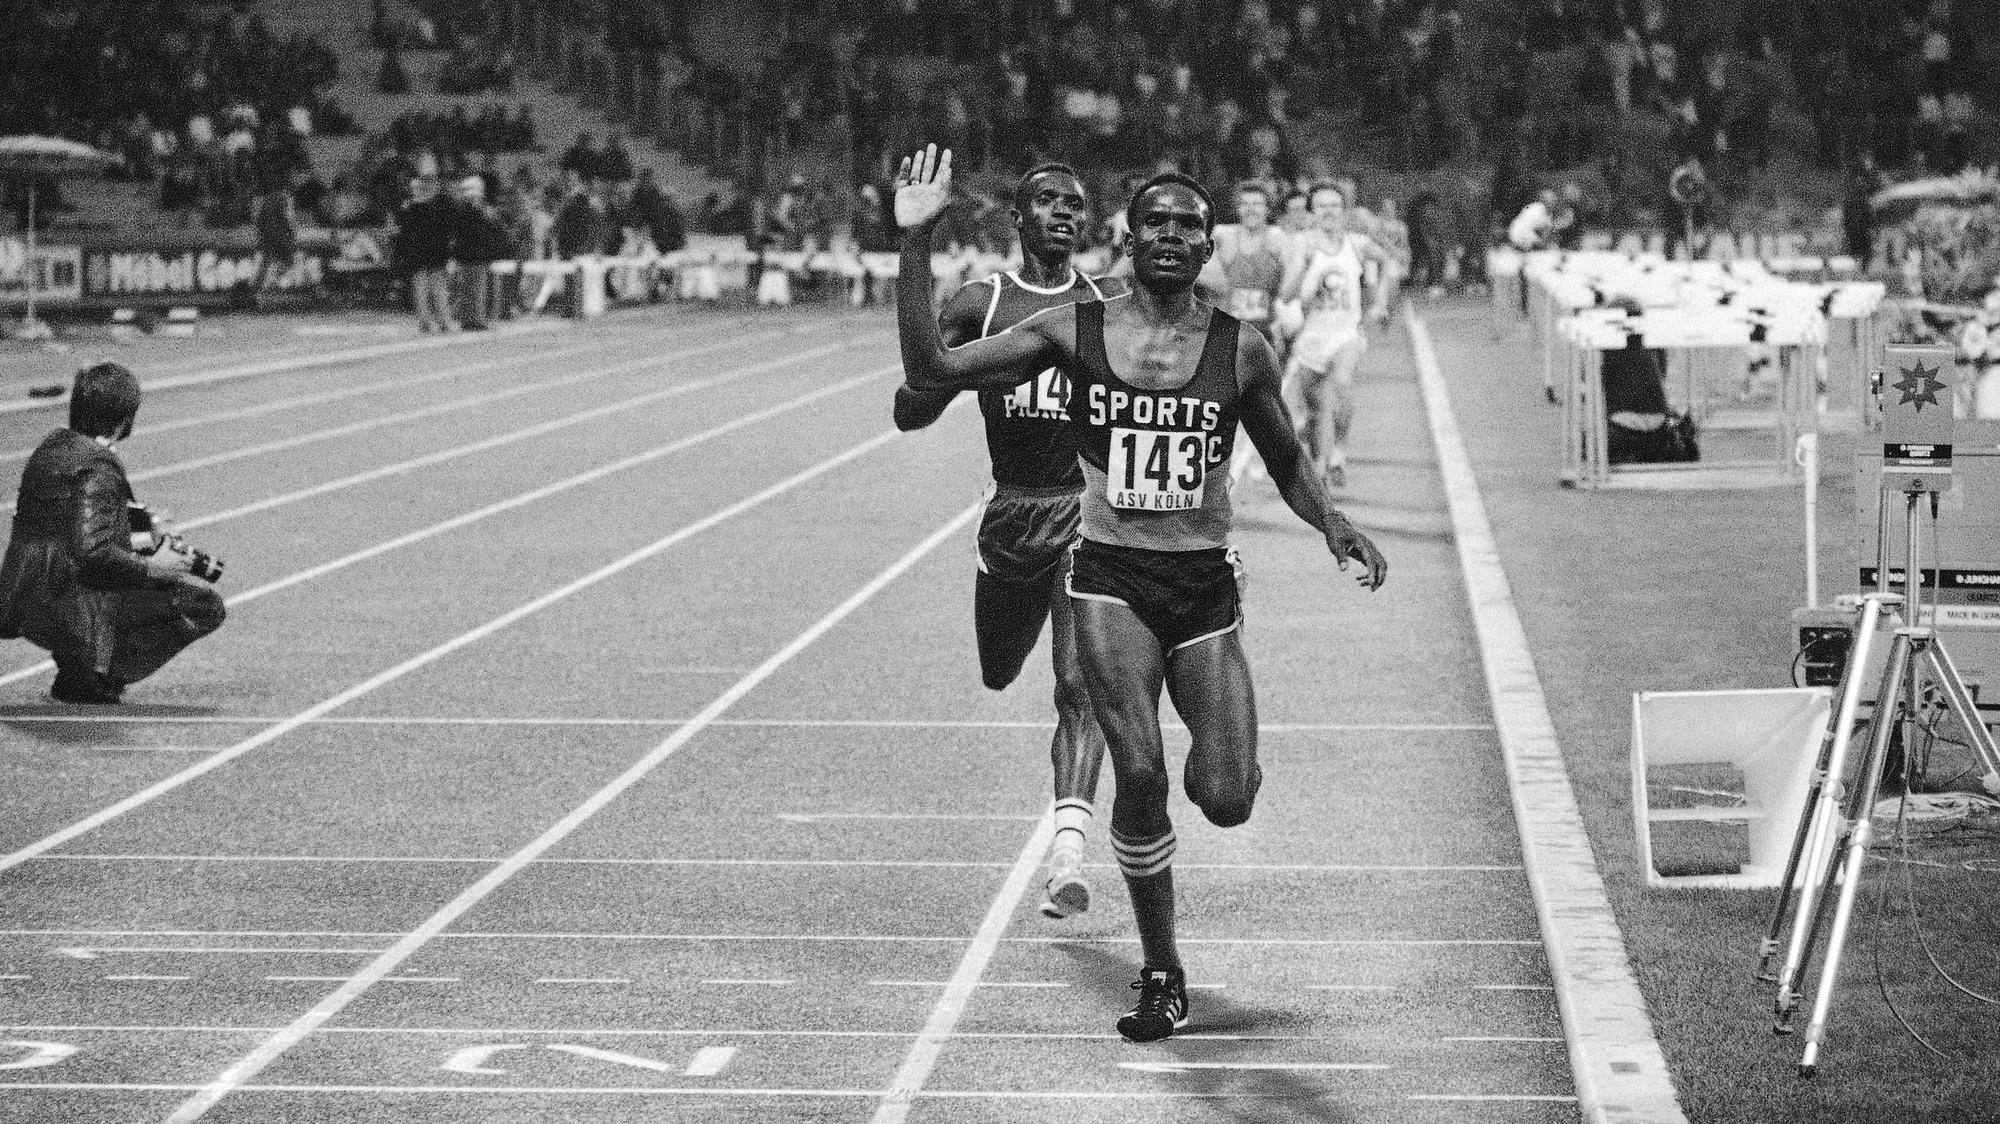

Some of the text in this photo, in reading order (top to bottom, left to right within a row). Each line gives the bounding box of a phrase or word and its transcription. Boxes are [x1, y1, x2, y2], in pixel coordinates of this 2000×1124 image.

[1089, 384, 1221, 431] SPORTS
[1121, 432, 1204, 492] 143
[1116, 491, 1194, 509] ASV KÖLN
